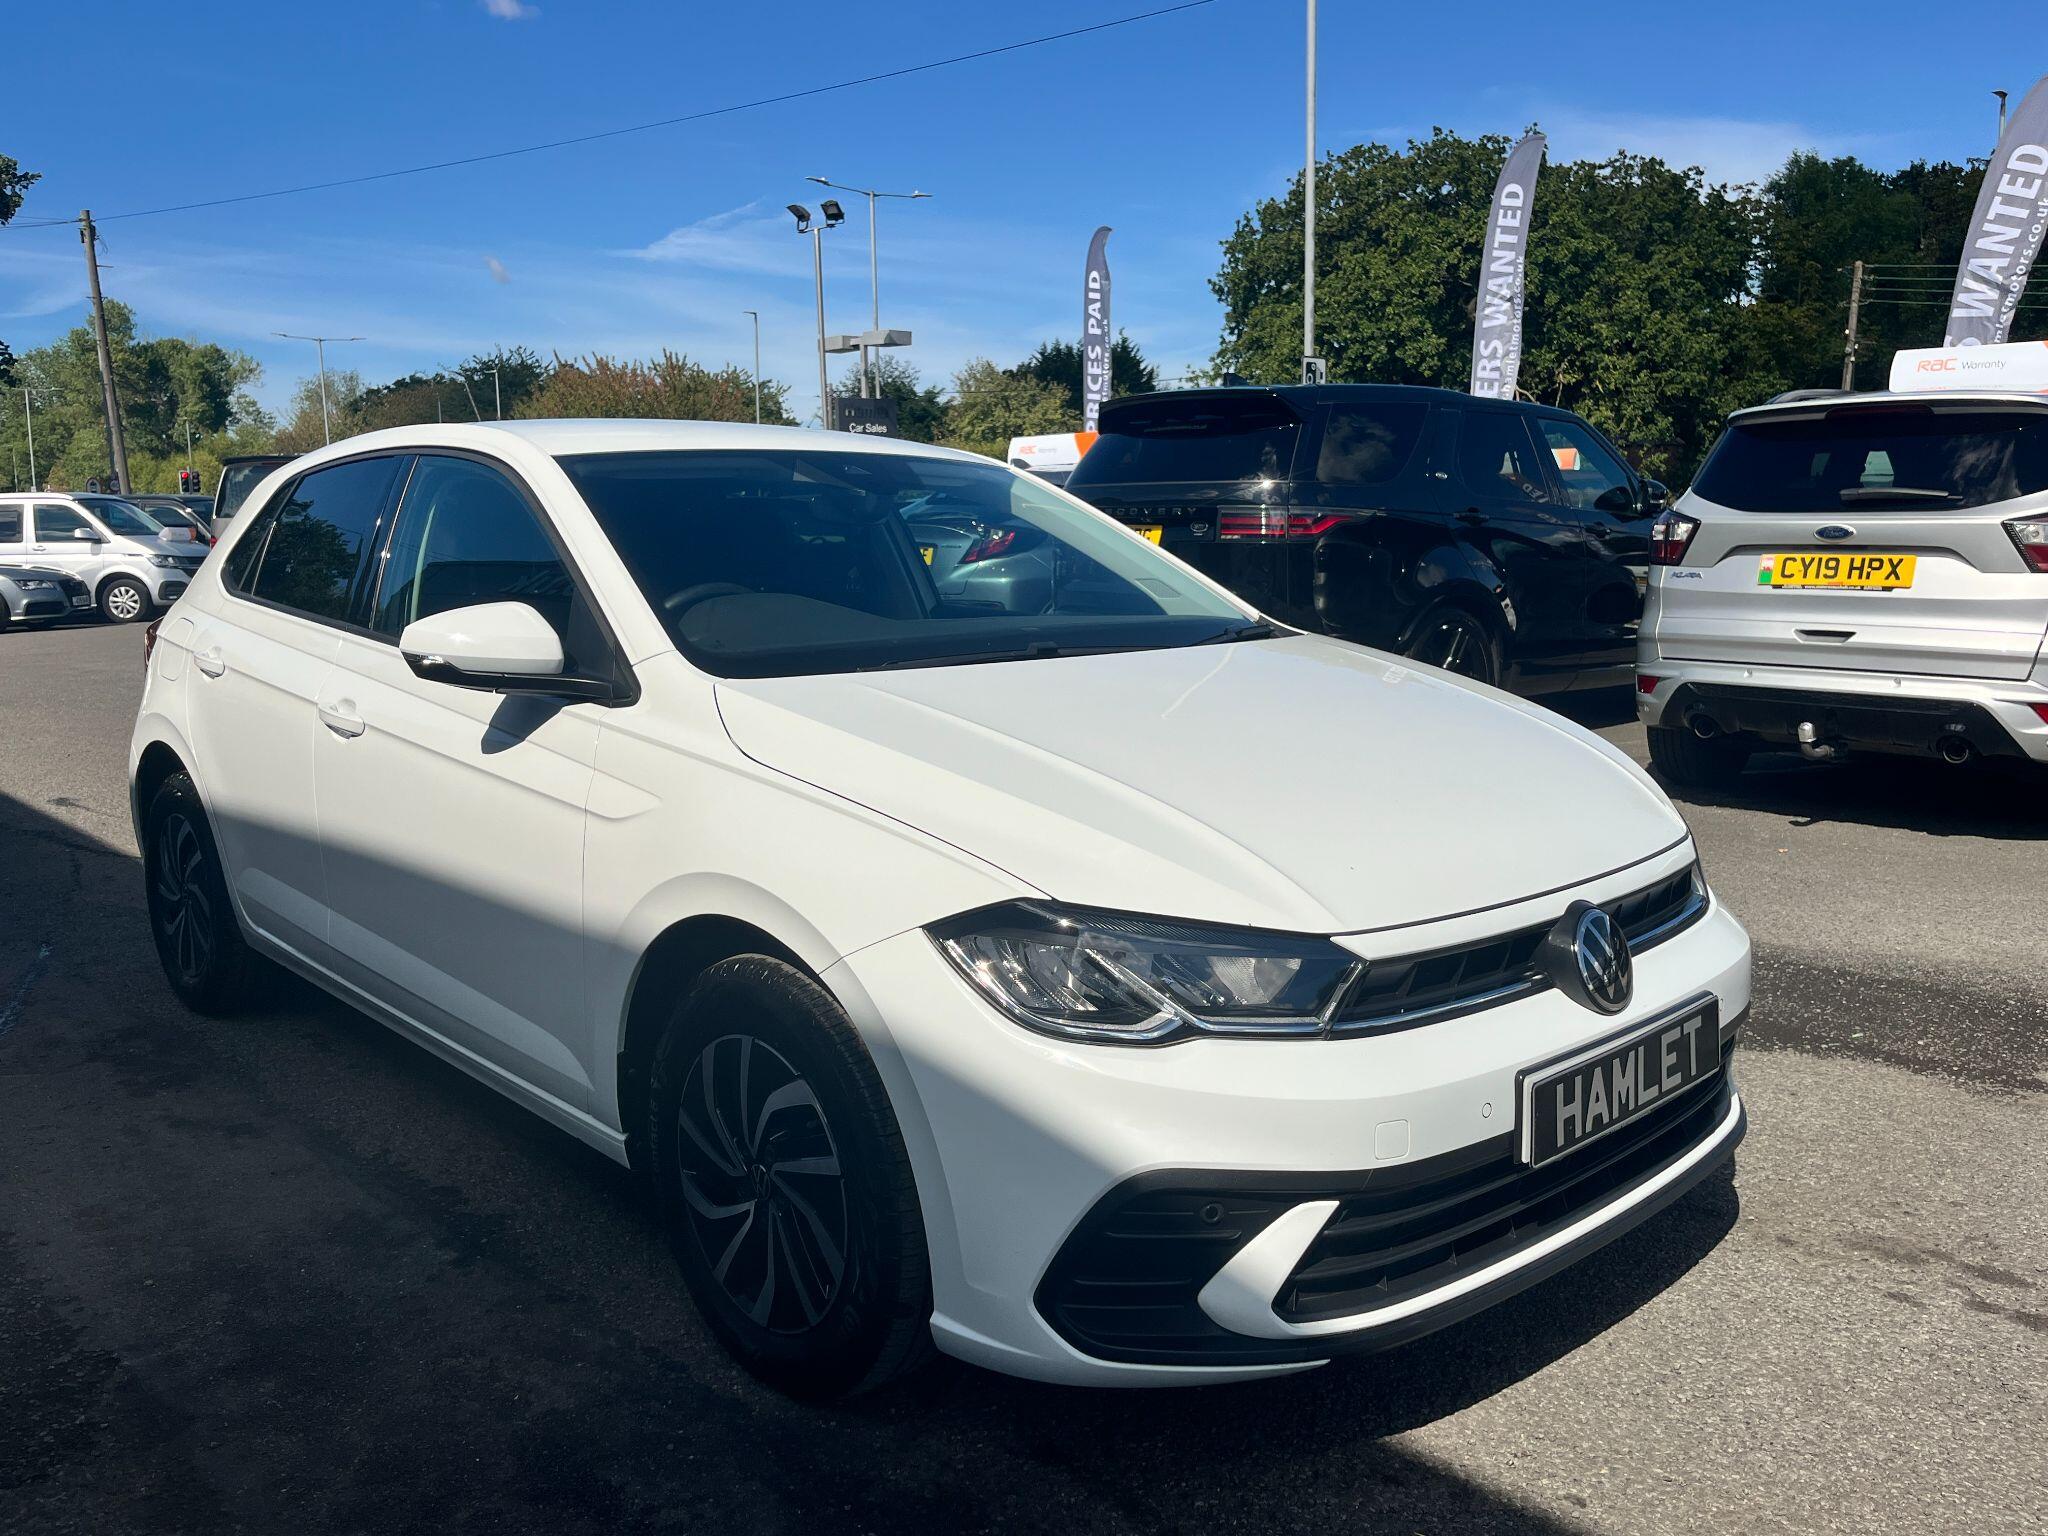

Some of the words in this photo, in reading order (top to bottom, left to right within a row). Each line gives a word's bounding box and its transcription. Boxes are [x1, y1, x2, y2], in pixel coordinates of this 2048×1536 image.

[1483, 183, 1524, 328] WANTED
[1952, 144, 2048, 317] WANTED
[1087, 270, 1102, 336] PAID
[1085, 345, 1102, 432] PRICES
[1475, 339, 1503, 398] ERS
[1962, 360, 2006, 370] Warranty
[849, 423, 863, 433] Car
[865, 423, 887, 433] Sales
[1104, 507, 1197, 515] SCOVERY
[1780, 557, 1841, 579] CY19
[1847, 558, 1904, 580] HPX
[1555, 1015, 1702, 1148] HAMLET
